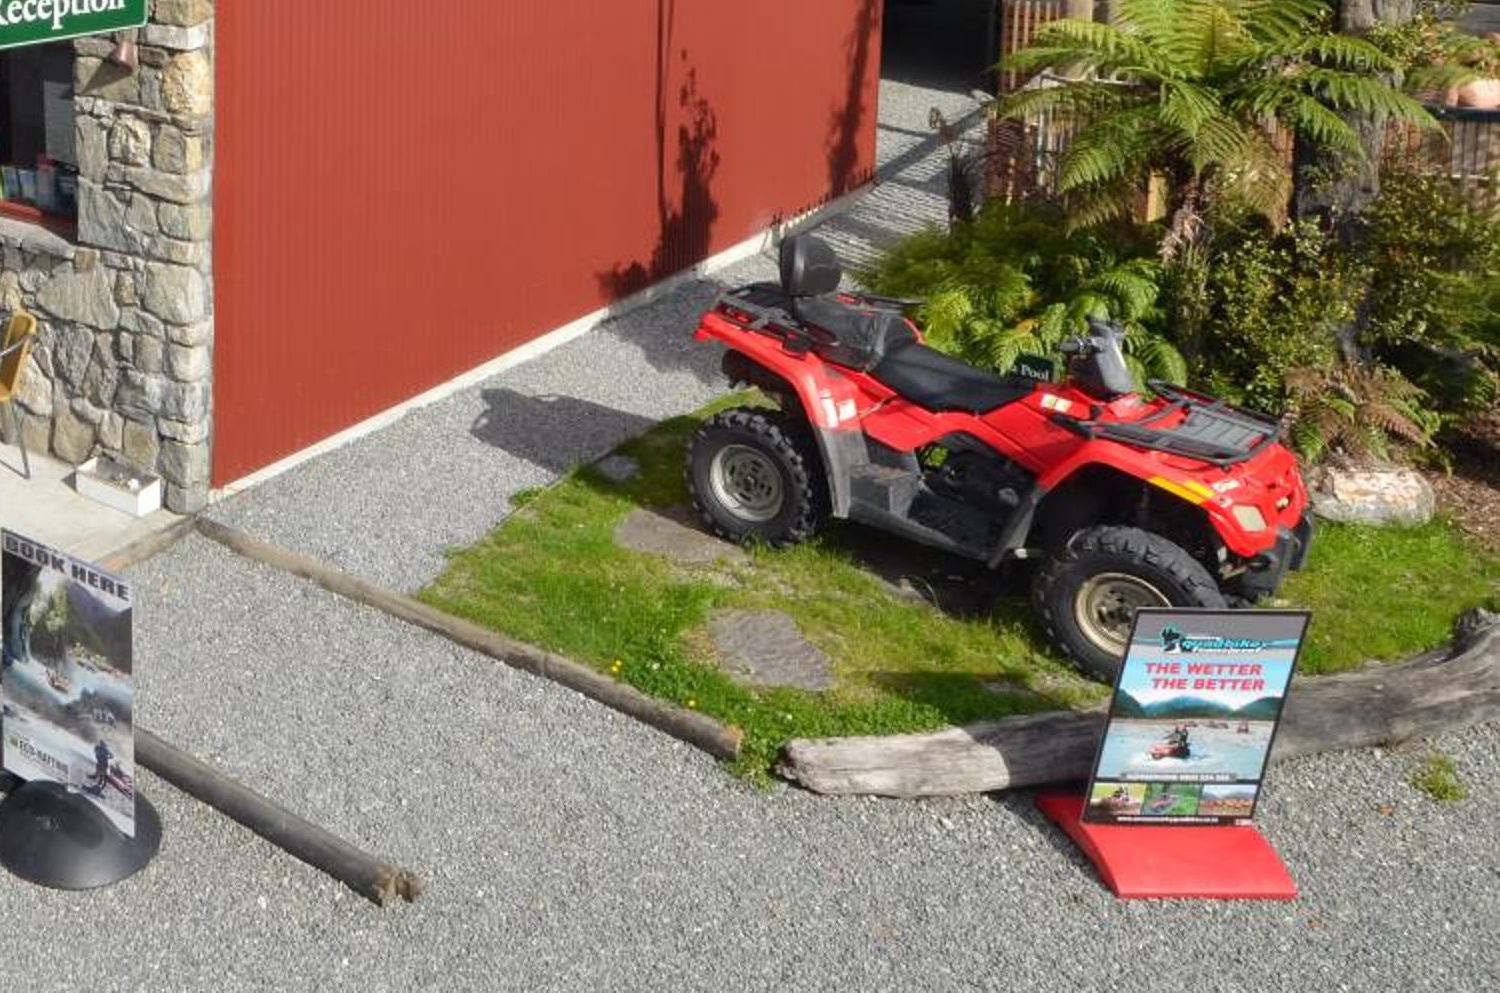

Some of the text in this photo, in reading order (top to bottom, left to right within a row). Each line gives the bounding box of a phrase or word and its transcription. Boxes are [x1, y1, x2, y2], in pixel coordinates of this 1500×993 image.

[1021, 364, 1049, 382] Pool
[4, 535, 130, 602] BOOK HERE
[1145, 662, 1263, 676] THE WETTER
[1152, 678, 1265, 692] THE BETTER
